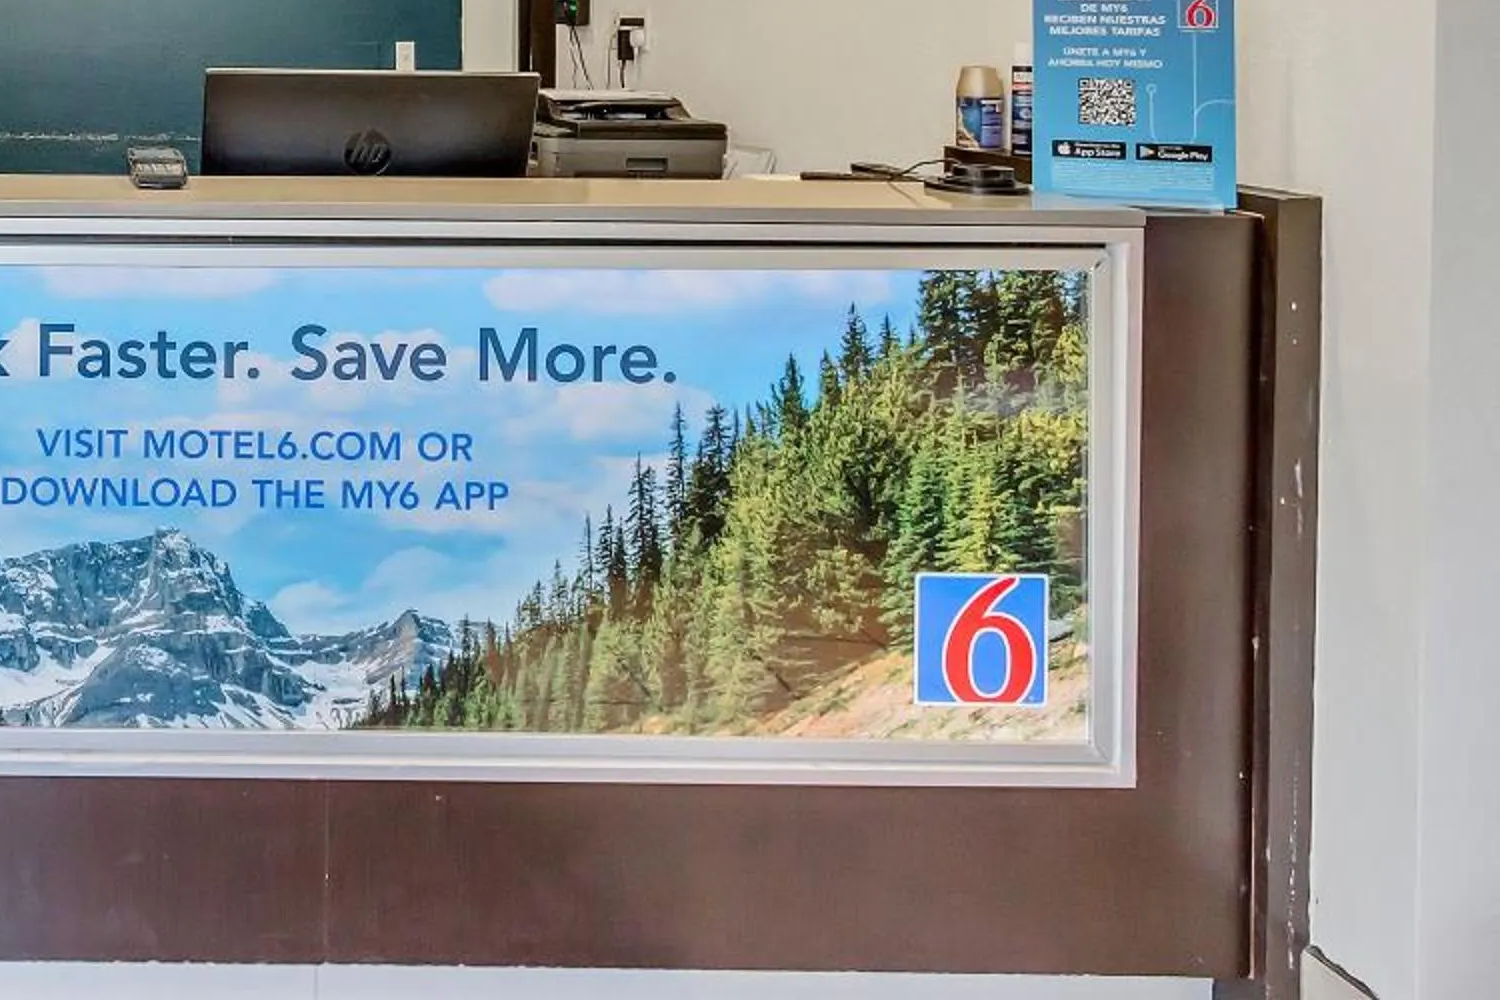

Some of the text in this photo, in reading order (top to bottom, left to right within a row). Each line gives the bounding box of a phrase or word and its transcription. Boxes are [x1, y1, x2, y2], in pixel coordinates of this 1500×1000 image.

[1080, 3, 1097, 13] DE
[1100, 15, 1167, 25] NUESTRAS
[1049, 26, 1107, 36] MEJORES
[1073, 146, 1095, 158] App
[1095, 147, 1121, 157] Store
[1157, 149, 1209, 161] Google Play
[39, 323, 260, 380] Faster.
[291, 323, 447, 382] Save
[479, 327, 677, 385] More.
[36, 428, 473, 462] VISIT MOTEL6.COM OR
[1, 475, 510, 512] DOWNLOAD THE MY6 APP
[942, 575, 1037, 706] 6
